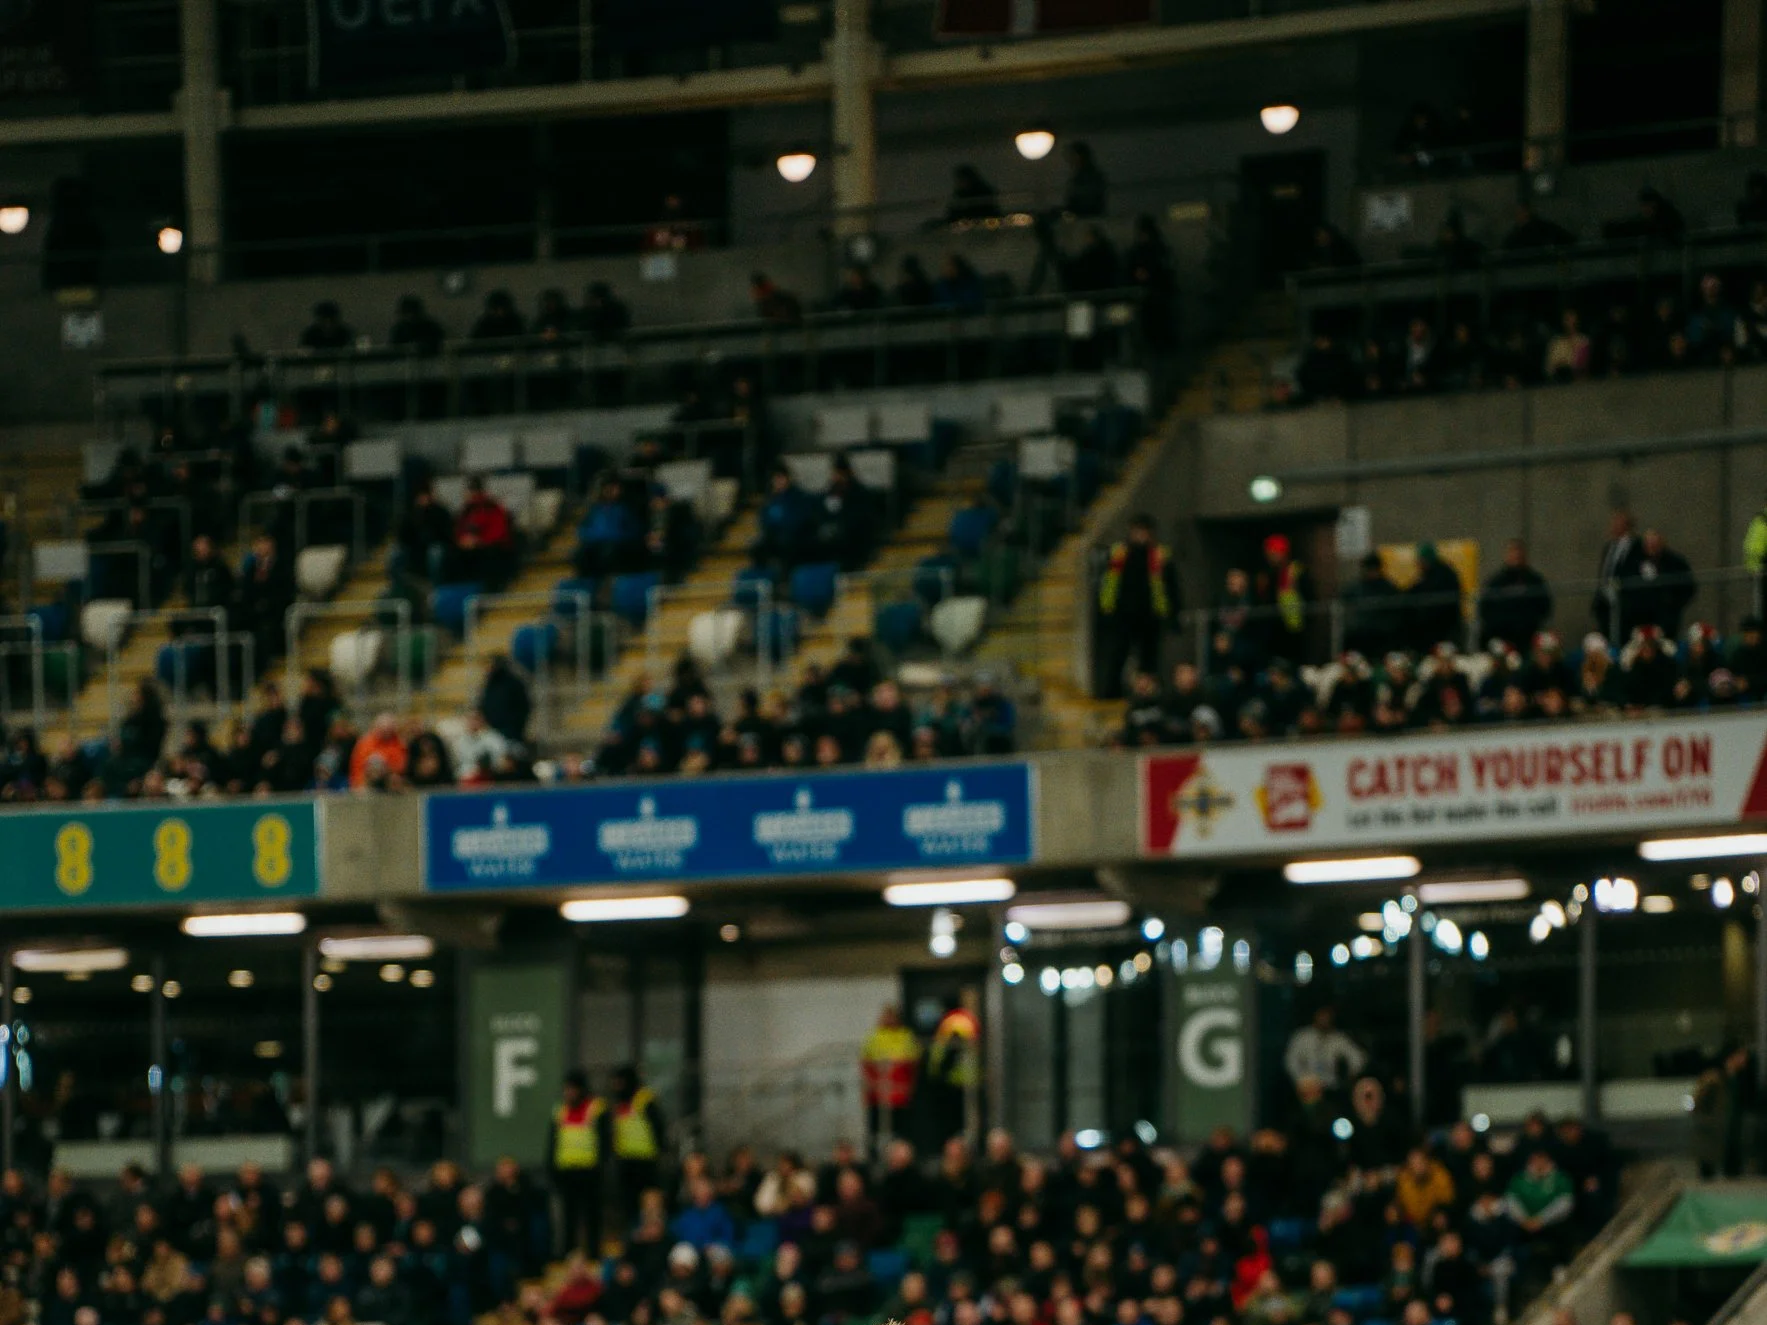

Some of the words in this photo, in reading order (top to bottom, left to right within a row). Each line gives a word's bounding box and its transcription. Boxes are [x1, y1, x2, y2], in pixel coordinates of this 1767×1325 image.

[1346, 756, 1459, 799] CATCH
[1471, 735, 1651, 791] YOURSELF
[1663, 733, 1712, 780] ON
[493, 1037, 539, 1118] F
[1177, 1005, 1243, 1089] G
